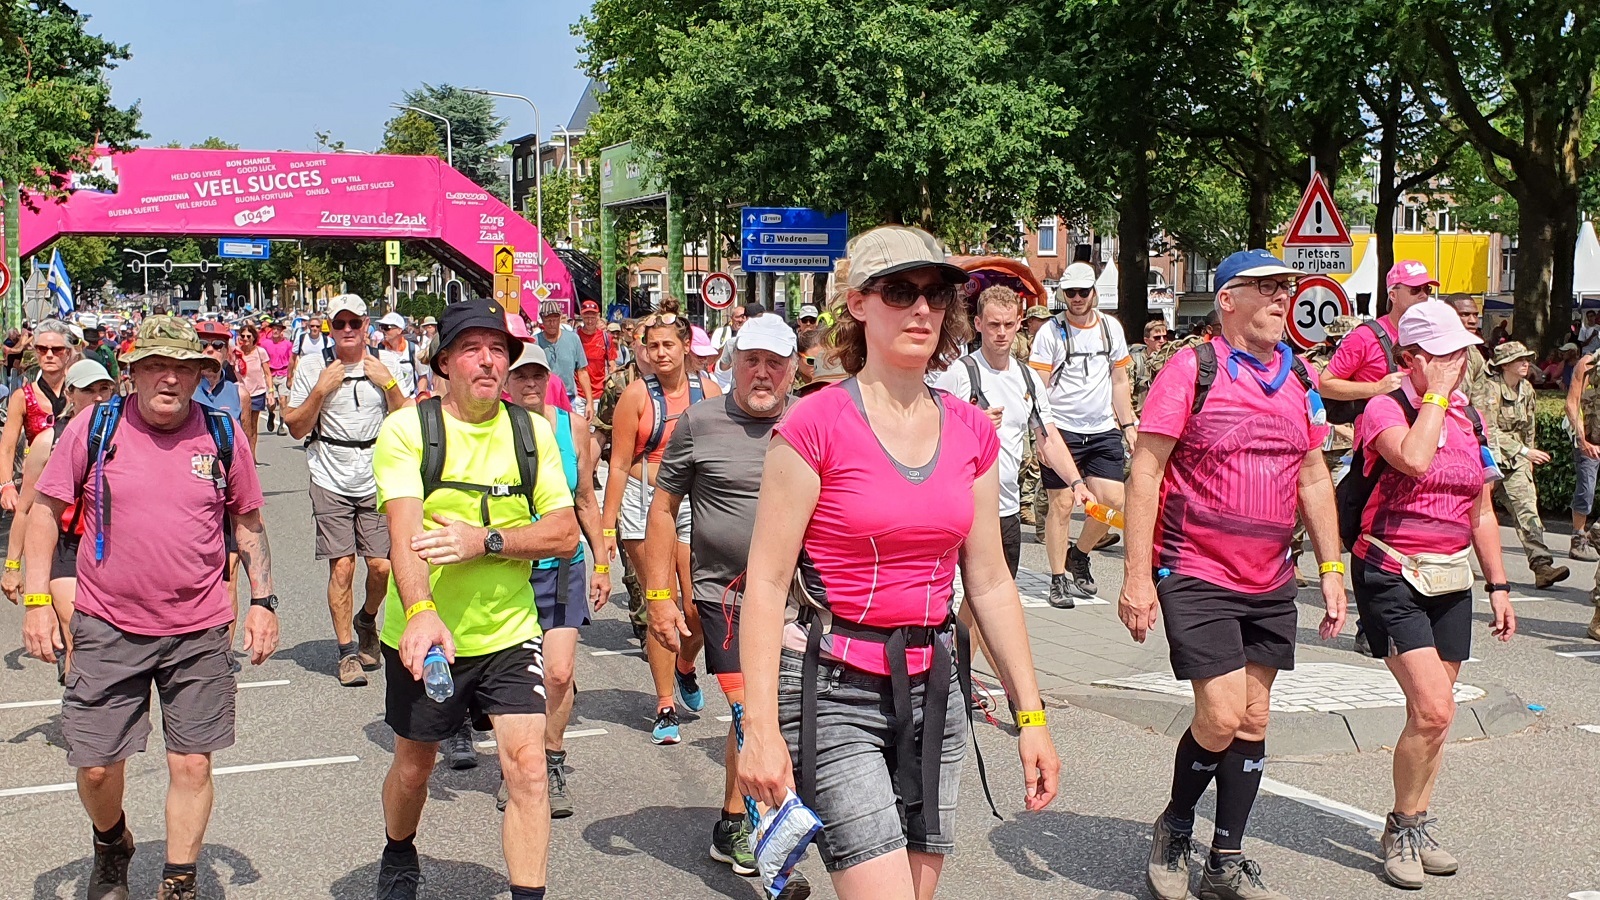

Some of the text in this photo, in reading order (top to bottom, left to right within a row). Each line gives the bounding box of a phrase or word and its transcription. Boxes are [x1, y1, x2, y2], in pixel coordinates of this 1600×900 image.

[226, 157, 271, 168] BON CHANCE
[290, 159, 327, 169] BOA SORTE
[236, 164, 276, 174] GOOD LUCK
[171, 170, 222, 181] HELD OG LYKKE
[331, 176, 347, 185] LYKA
[194, 170, 322, 198] VEEL SUCCES
[346, 181, 394, 192] MEGET SUCCES
[235, 191, 294, 204] BUONA FORTUNA
[306, 188, 330, 196] ONNEA
[140, 193, 190, 204] POWODZENIA
[175, 199, 217, 210] VIEL ERFOLG
[108, 206, 160, 218] BUENA SUERTE
[320, 211, 427, 226] Zorg van de Zaak
[480, 214, 504, 227] Zorg
[480, 230, 504, 240] Zaak
[1298, 248, 1340, 259] Fietsers
[764, 257, 827, 265] Vierdaagseplein
[1292, 259, 1345, 272] op rijbaan
[1297, 300, 1338, 329] 30
